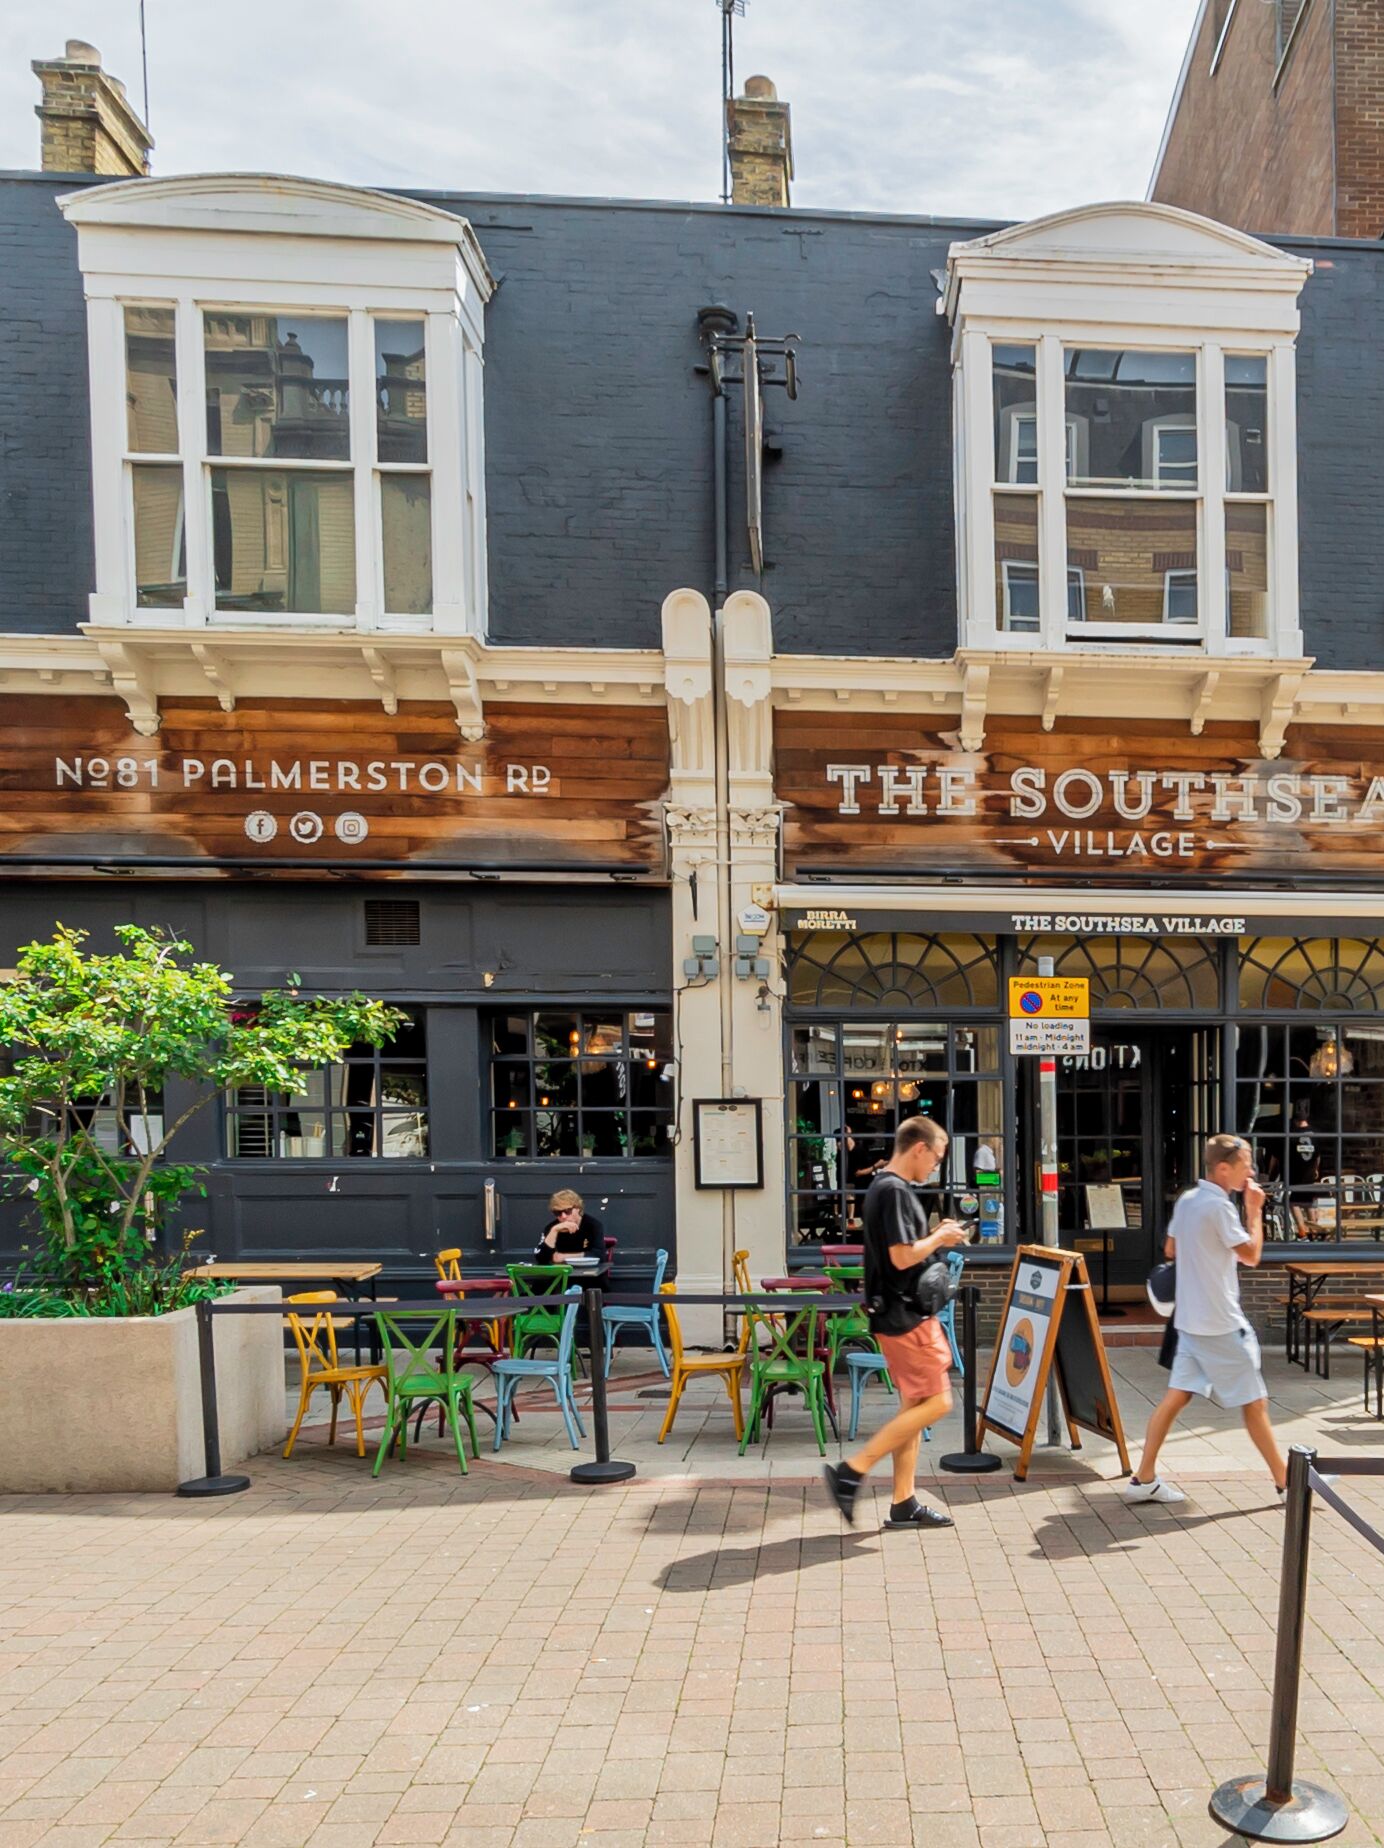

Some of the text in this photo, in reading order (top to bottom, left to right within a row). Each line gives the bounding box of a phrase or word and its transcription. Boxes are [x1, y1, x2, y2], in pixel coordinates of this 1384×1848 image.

[182, 758, 482, 792] PALMERSTON
[826, 763, 977, 817] THE
[1046, 829, 1196, 858] VILLAGE
[806, 910, 848, 920] BIRRA
[797, 919, 857, 930] MORETTI
[1011, 914, 1246, 934] THE SOUTHSEA VILLAGE
[1013, 981, 1085, 989] Pedestrian Zone
[1050, 994, 1079, 1003] At any
[1025, 1022, 1074, 1031] No loading
[1045, 1032, 1085, 1042] Midnight
[1016, 1043, 1056, 1052] midnight
